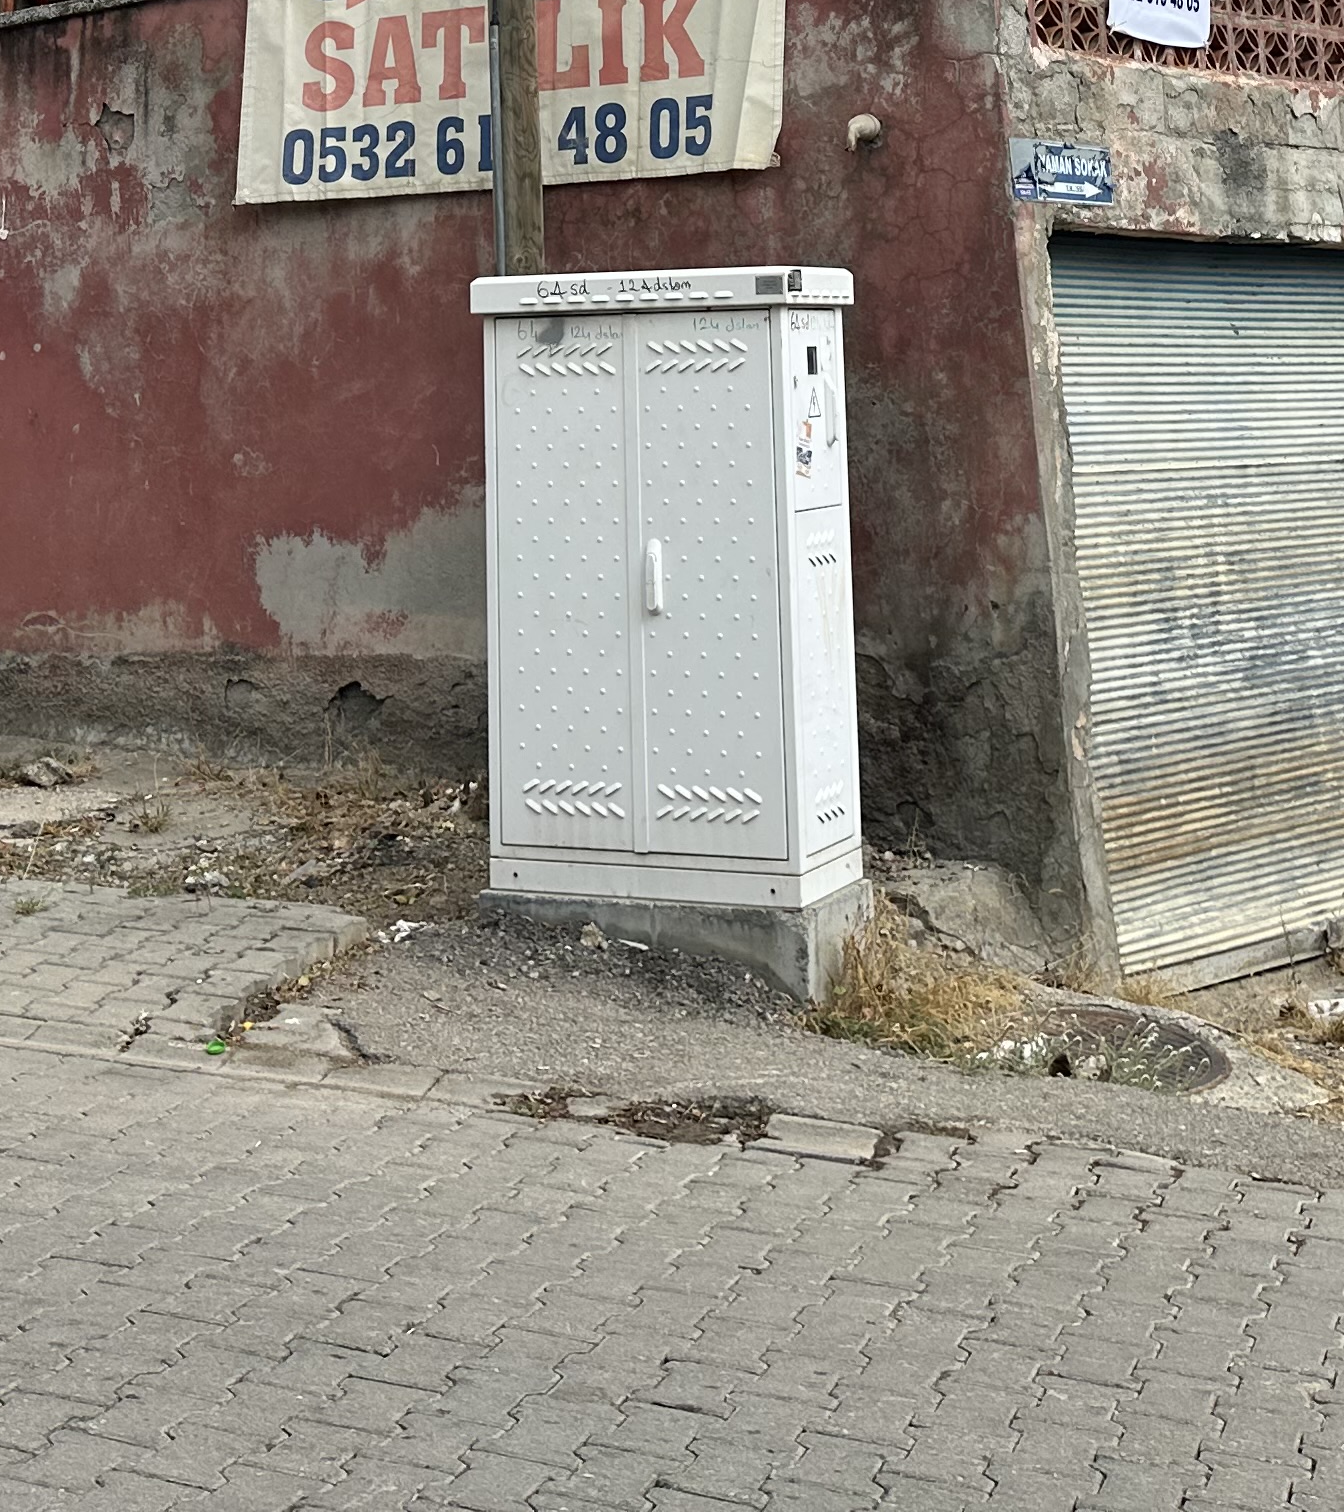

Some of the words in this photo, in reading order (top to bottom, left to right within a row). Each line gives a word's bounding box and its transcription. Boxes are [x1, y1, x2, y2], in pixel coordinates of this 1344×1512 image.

[282, 120, 416, 186] 0532
[436, 113, 494, 176] 61
[557, 102, 628, 166] 48
[649, 93, 713, 160] 05
